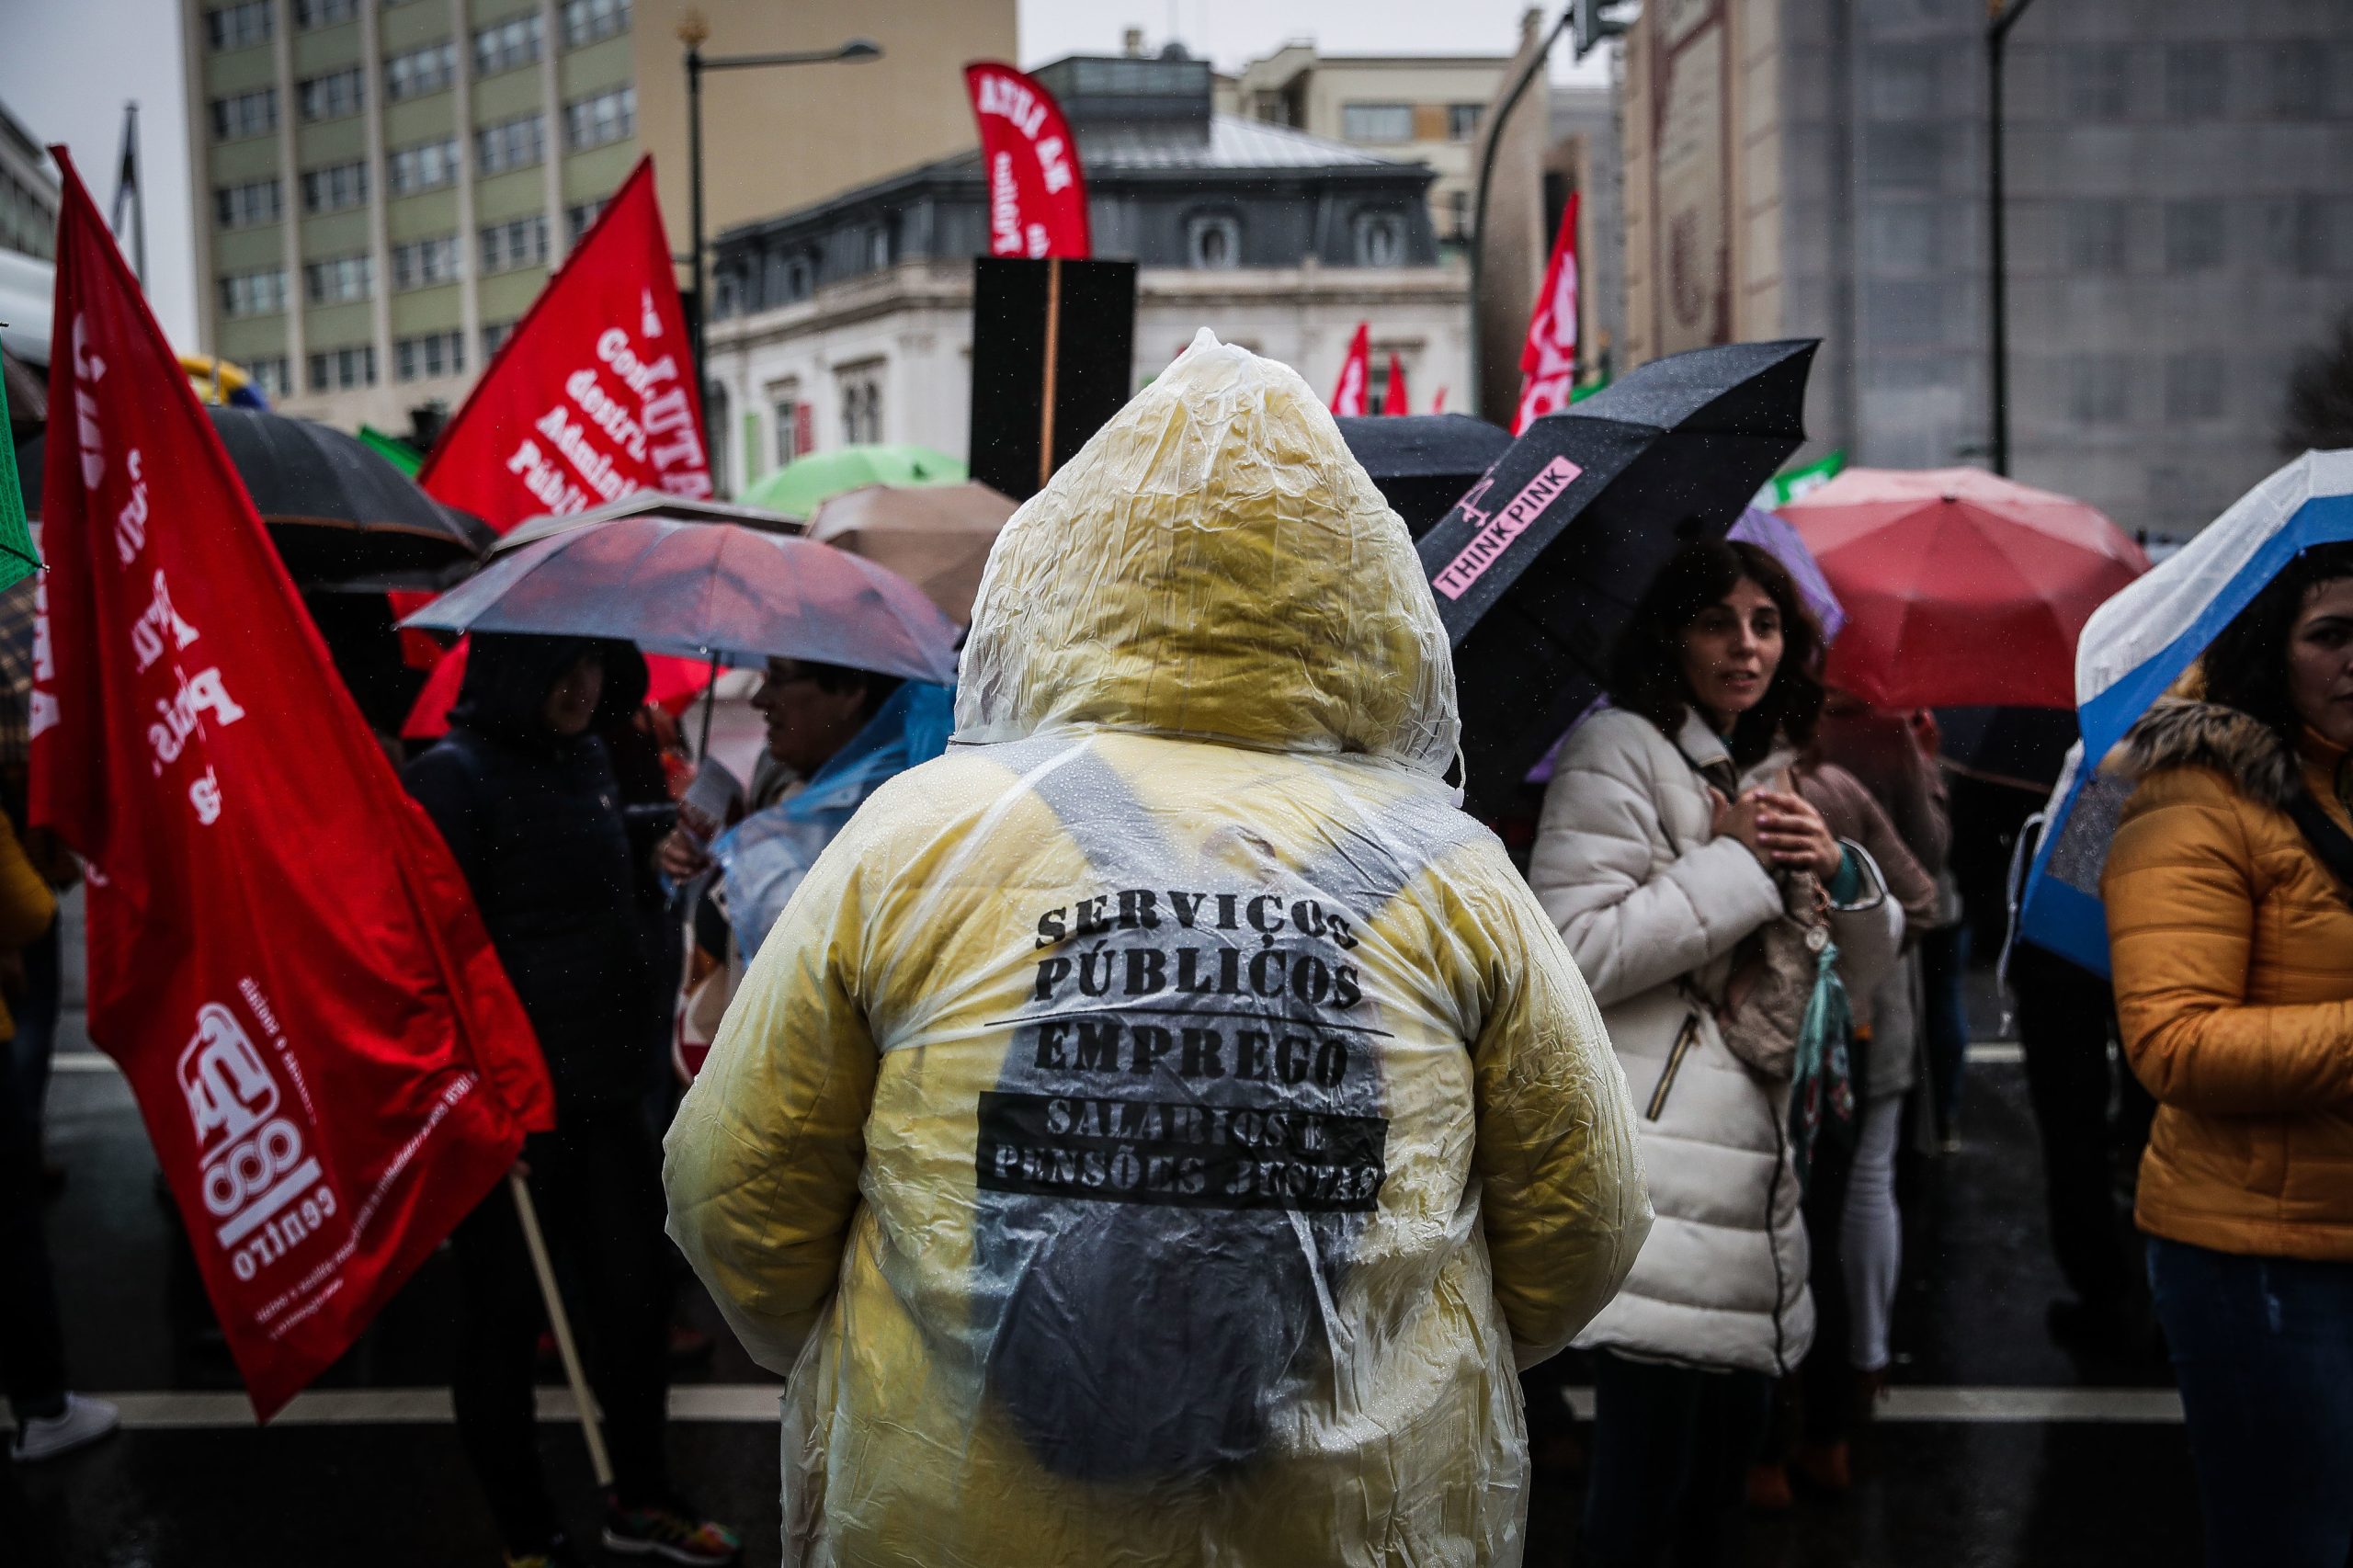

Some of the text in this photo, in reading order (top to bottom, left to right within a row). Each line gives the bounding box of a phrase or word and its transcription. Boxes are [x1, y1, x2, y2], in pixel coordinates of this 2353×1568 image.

[1440, 465, 1571, 594] THINK PINK
[1035, 889, 1359, 950] SERVIÇOS
[1034, 939, 1363, 1010] PÚBLICOS
[1034, 1022, 1348, 1088] EMPREGO
[994, 1144, 1206, 1195] PENSÕES
